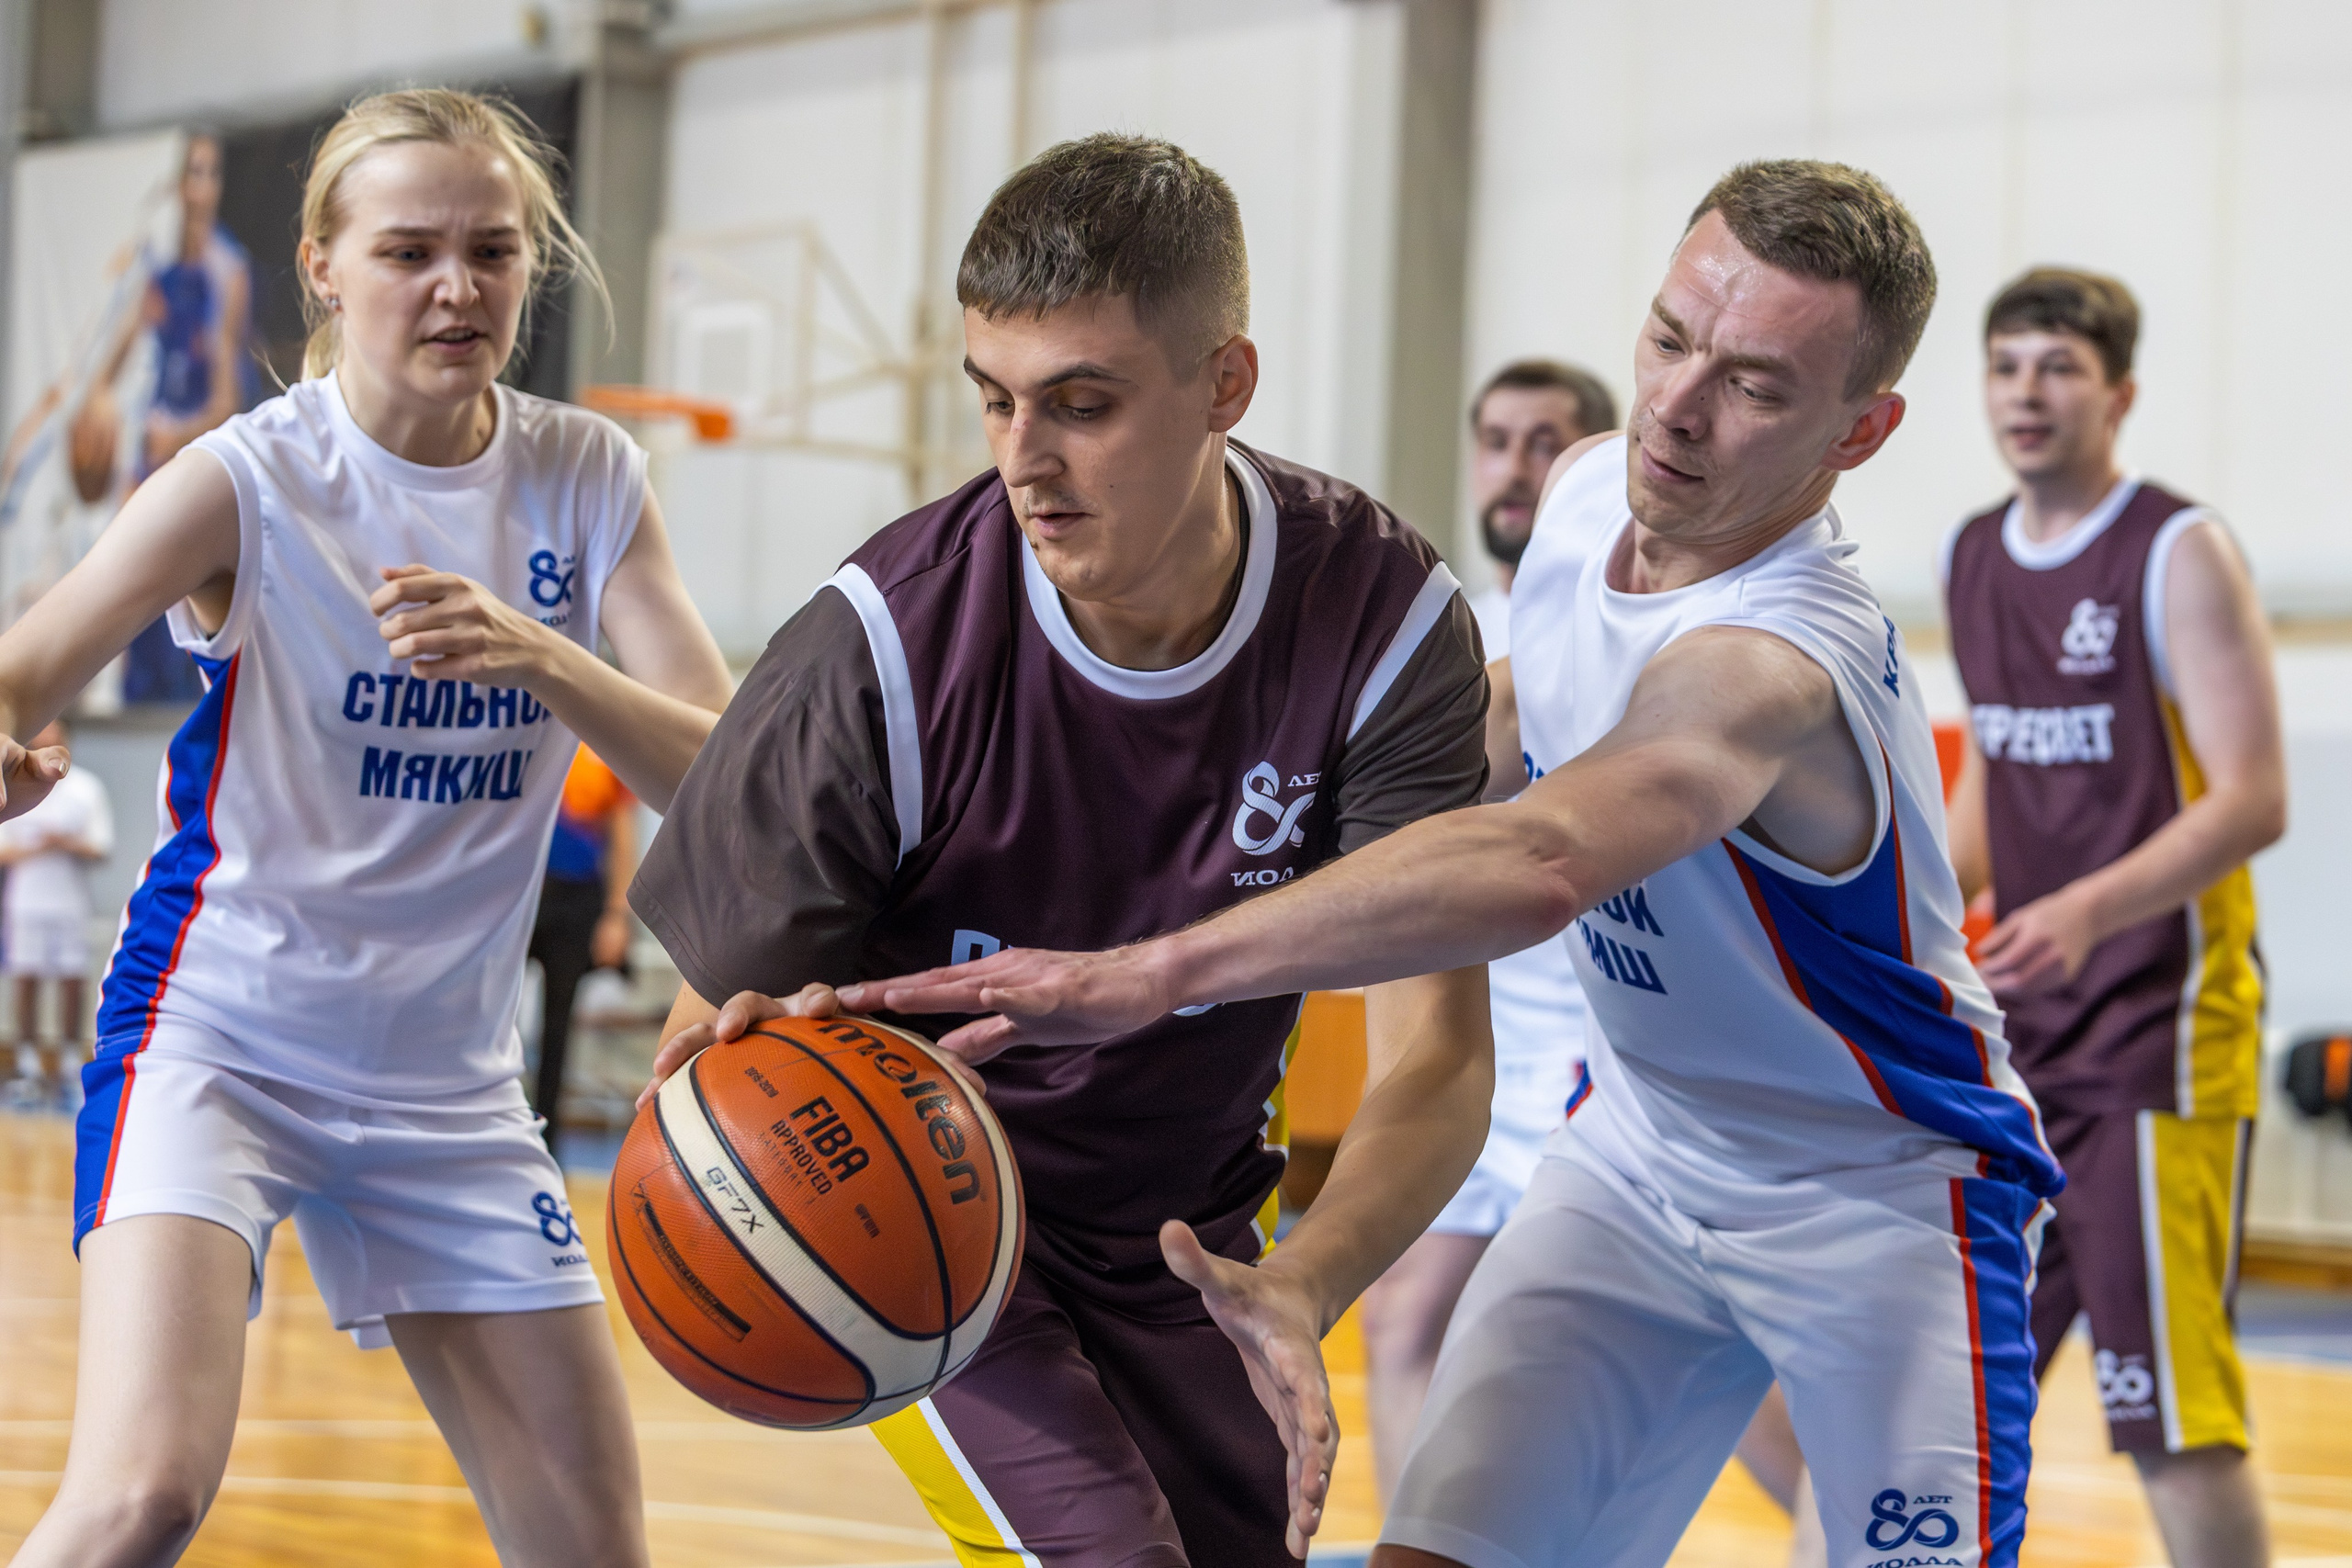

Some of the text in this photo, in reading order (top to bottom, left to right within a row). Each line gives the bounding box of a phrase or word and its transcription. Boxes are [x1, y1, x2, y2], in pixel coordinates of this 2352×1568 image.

[342, 671, 552, 728] СТАЛЬНО
[358, 745, 533, 806] МЯКИШ
[789, 1095, 870, 1183] FIBA
[816, 1023, 980, 1205] molten
[770, 1120, 832, 1195] APPROVED
[707, 1168, 764, 1233] GF7X
